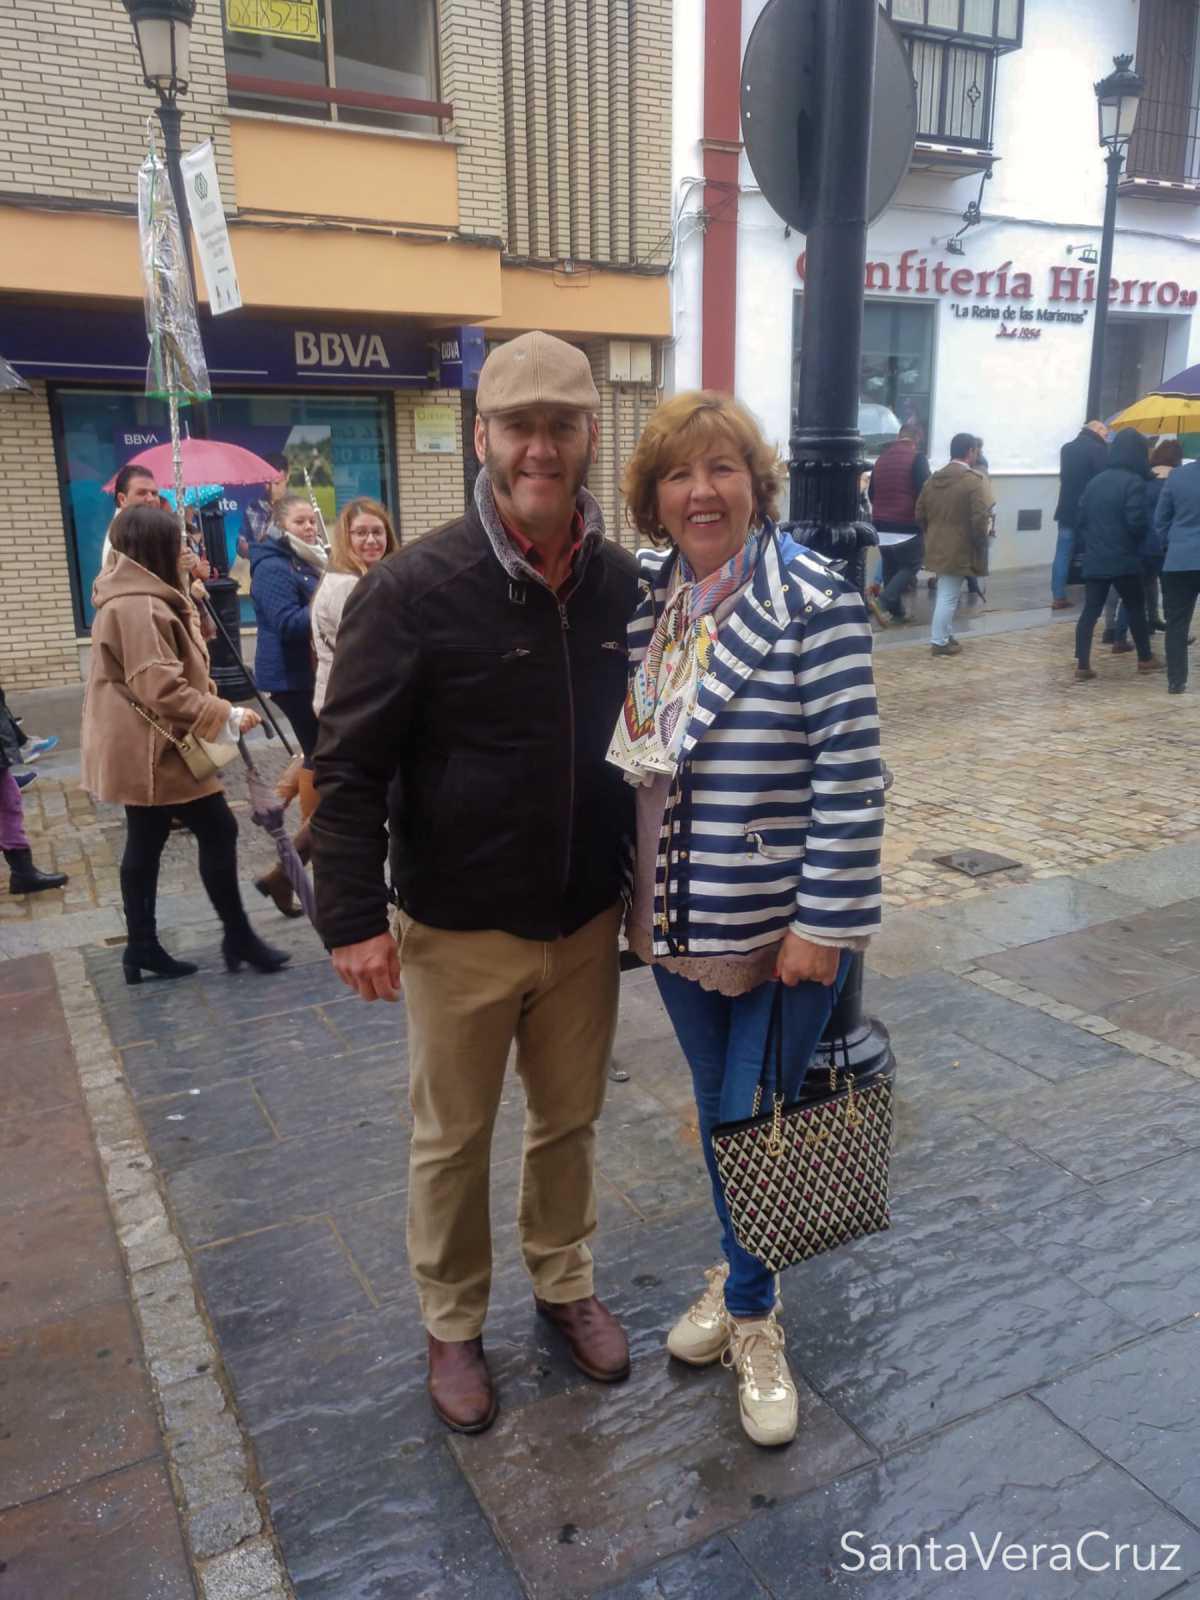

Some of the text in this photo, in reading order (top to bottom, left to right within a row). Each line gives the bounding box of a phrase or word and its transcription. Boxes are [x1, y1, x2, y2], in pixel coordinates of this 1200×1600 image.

[796, 249, 1032, 299] nfitería
[971, 305, 1000, 320] Reina
[1002, 305, 1016, 320] de
[1019, 306, 1034, 321] las
[294, 331, 390, 369] BBVA
[441, 341, 460, 360] BBVA
[124, 433, 158, 445] BBVA
